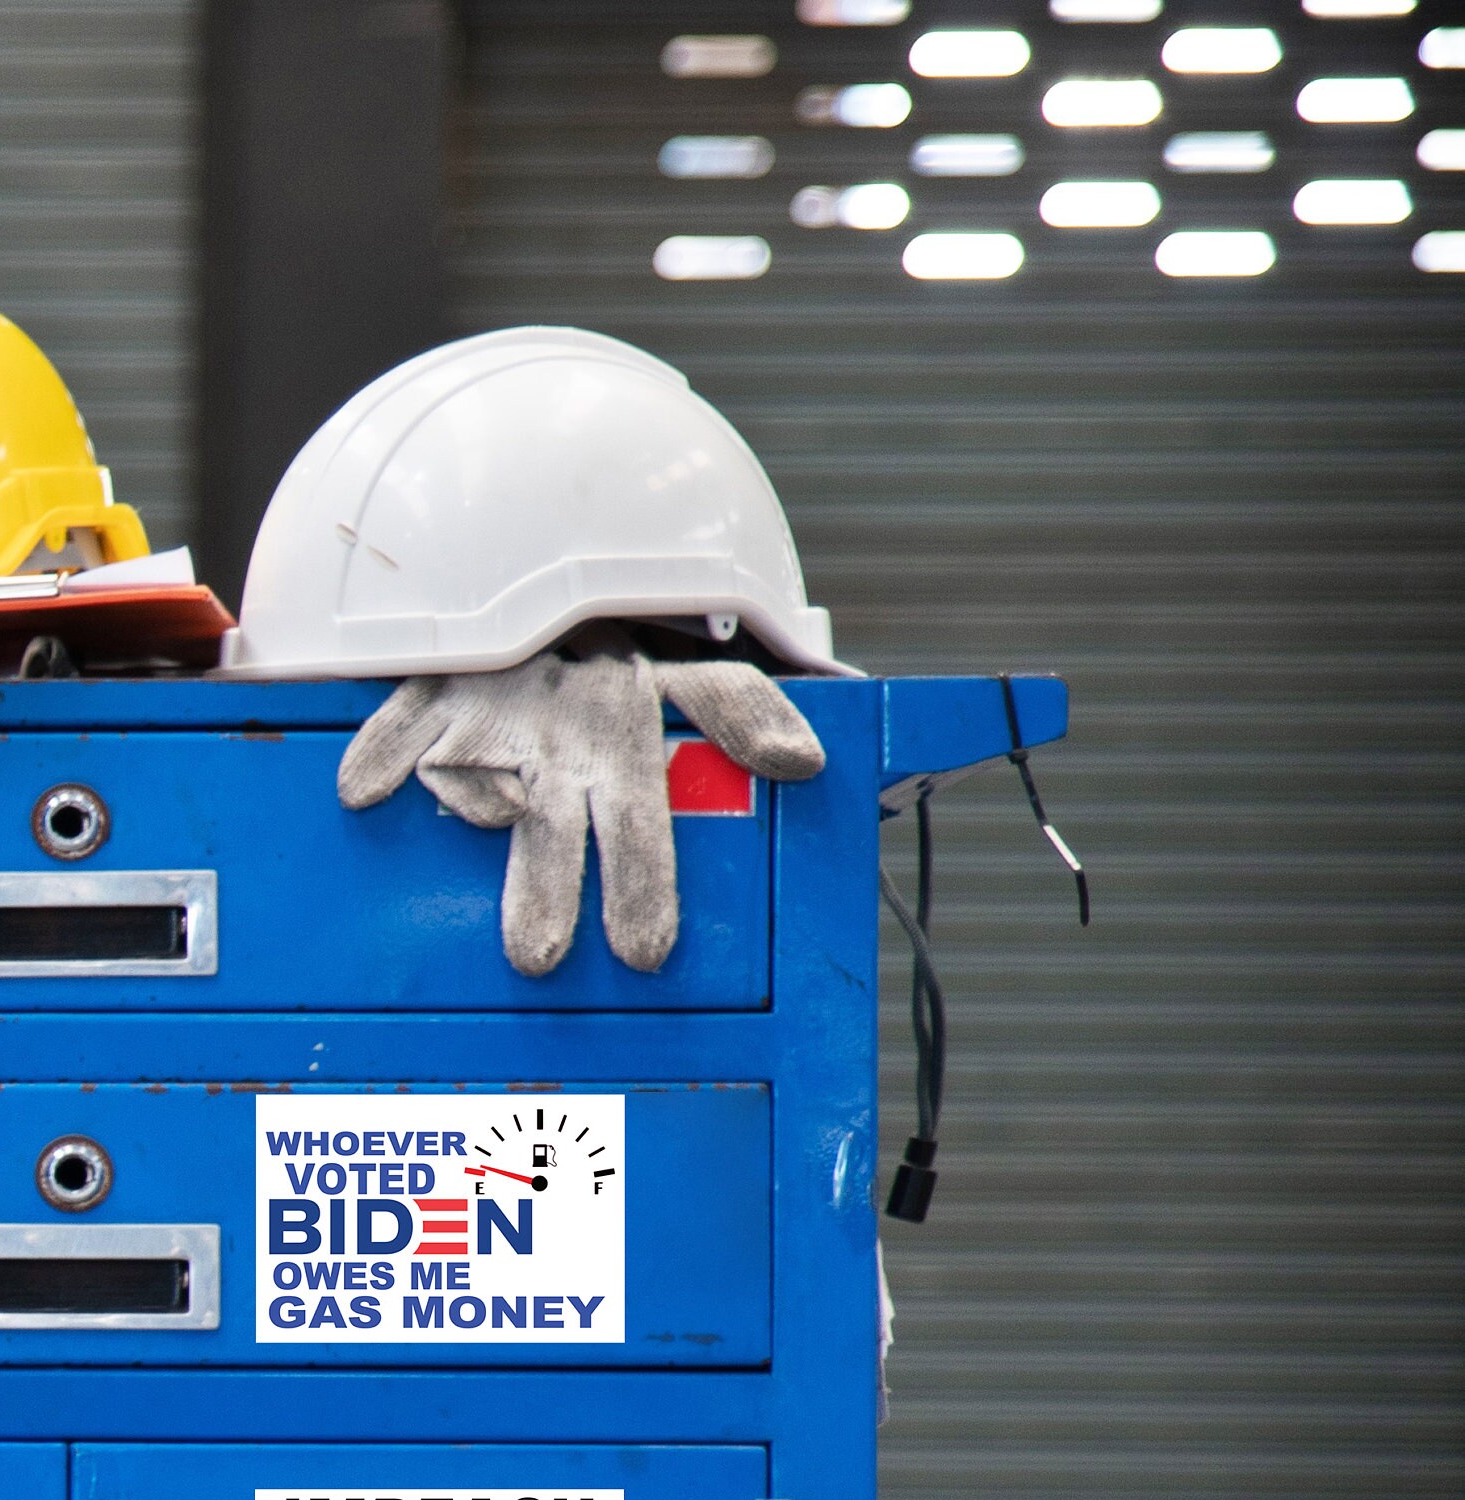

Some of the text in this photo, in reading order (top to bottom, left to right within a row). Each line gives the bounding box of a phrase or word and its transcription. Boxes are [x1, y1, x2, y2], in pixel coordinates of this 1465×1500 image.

[266, 1131, 467, 1156] WHOEVER
[285, 1163, 435, 1195] VOTED
[474, 1181, 485, 1195] E
[593, 1181, 604, 1195] F
[268, 1198, 533, 1255] BIDEN
[273, 1262, 471, 1291] OWES ME
[268, 1295, 605, 1329] GAS MONEY
